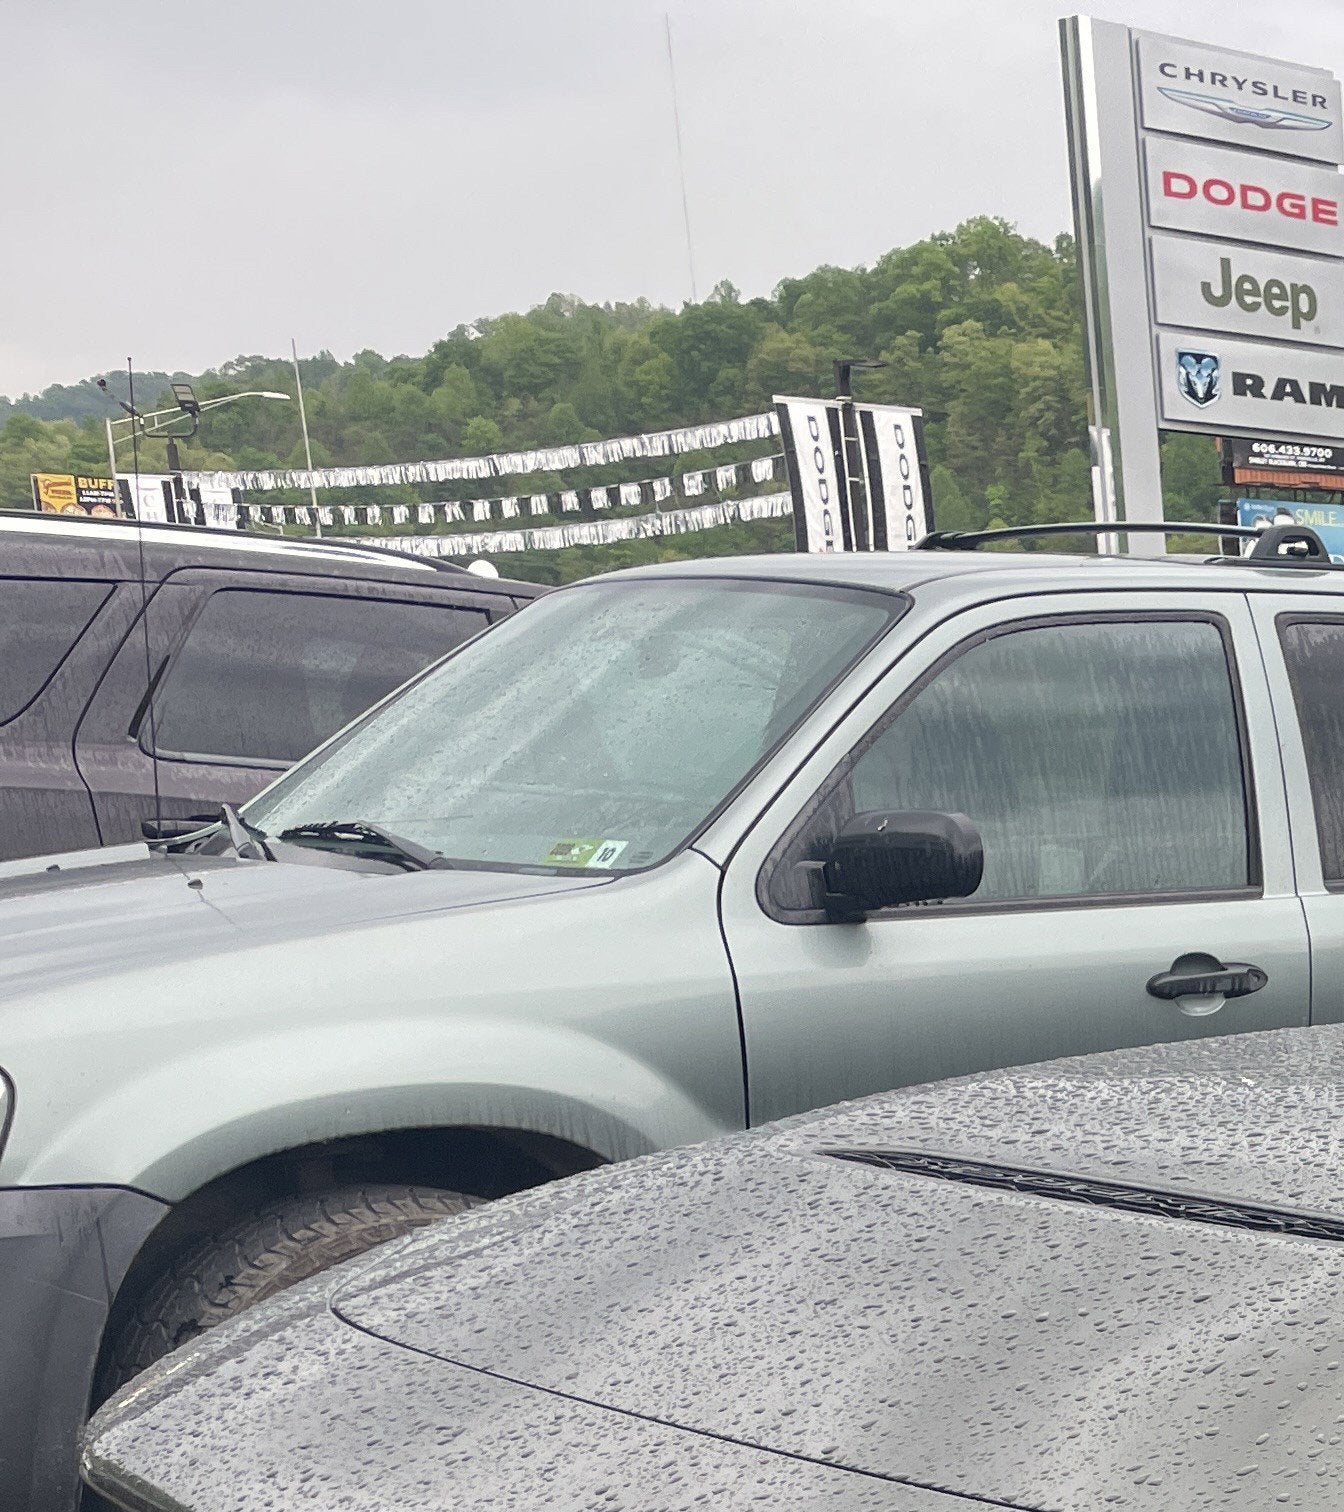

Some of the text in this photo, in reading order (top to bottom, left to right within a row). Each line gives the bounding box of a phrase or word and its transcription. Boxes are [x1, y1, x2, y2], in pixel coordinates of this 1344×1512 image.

[1158, 62, 1328, 109] CHRYSLER
[1162, 170, 1338, 226] DODGE
[1200, 257, 1318, 329] Jeep
[77, 477, 114, 490] BUFF
[893, 424, 917, 550] DODG
